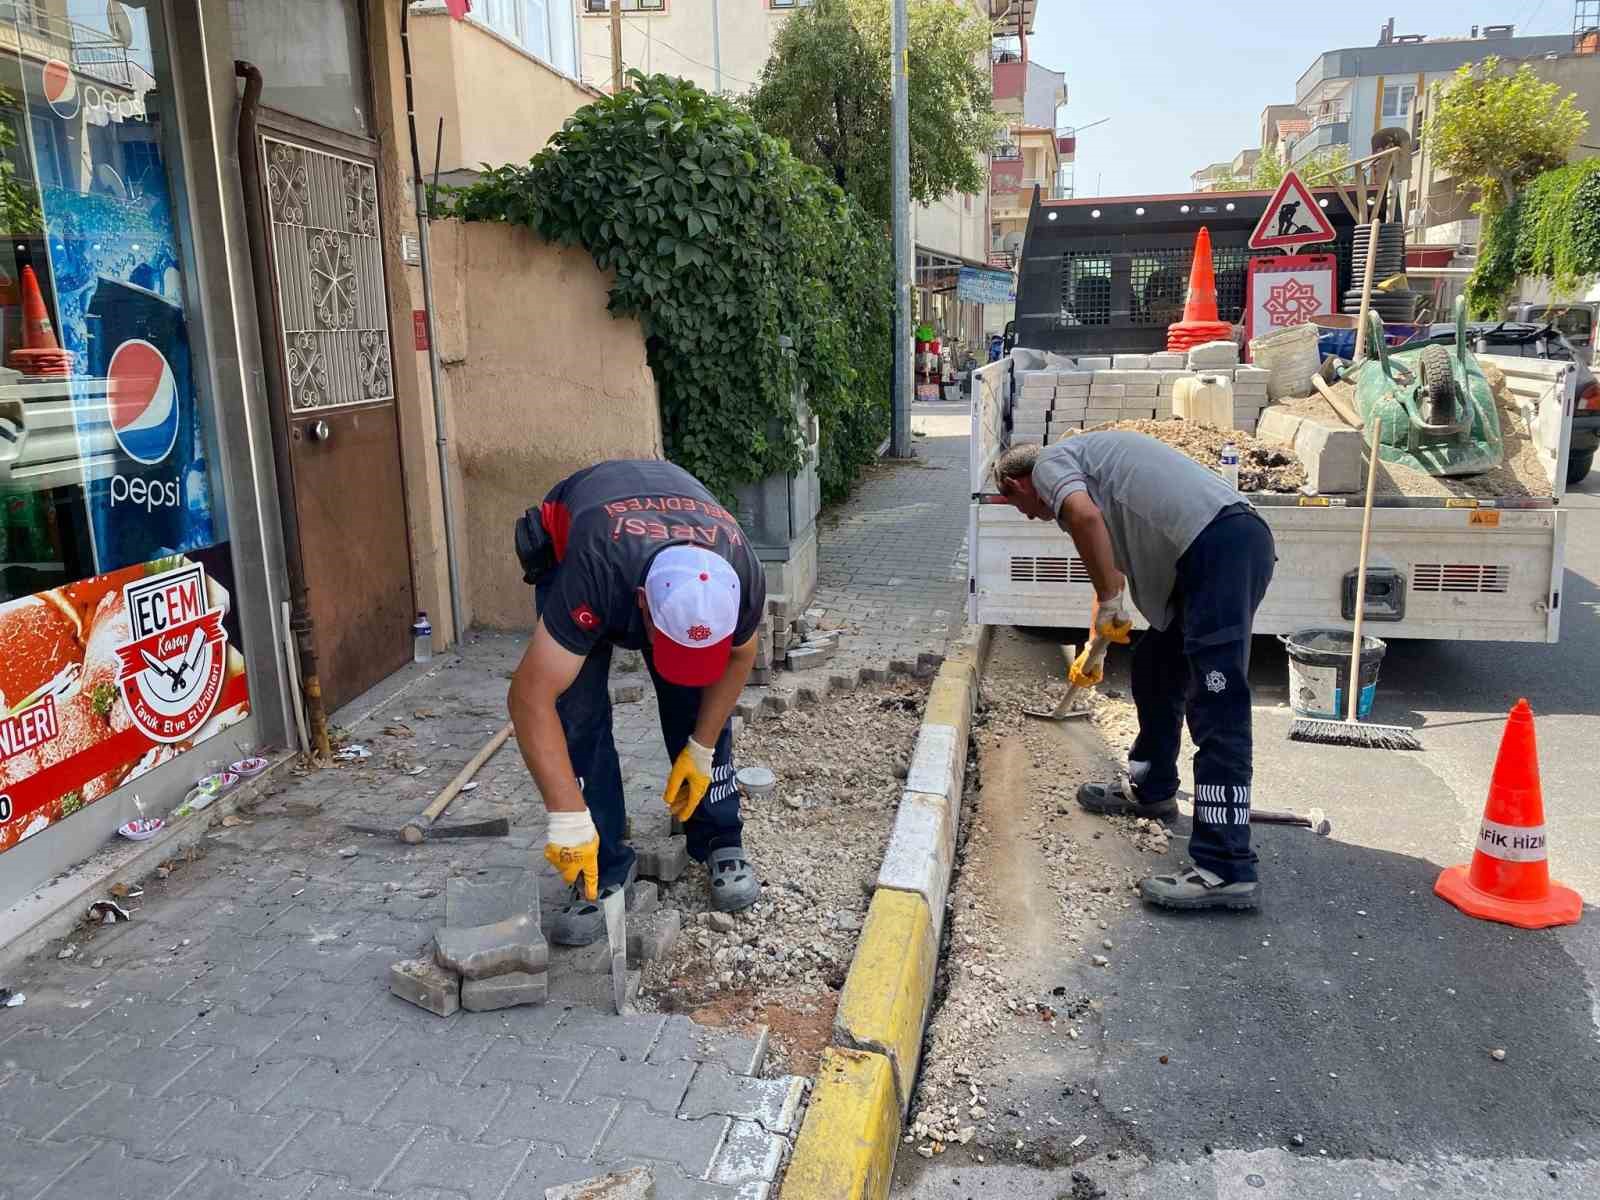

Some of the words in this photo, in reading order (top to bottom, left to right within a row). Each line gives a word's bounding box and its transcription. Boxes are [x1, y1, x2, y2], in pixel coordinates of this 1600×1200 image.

[110, 474, 181, 512] pepsi
[136, 580, 199, 637] ECEM
[157, 633, 189, 658] Kasap
[134, 698, 160, 730] Tavuk
[174, 720, 186, 732] ve
